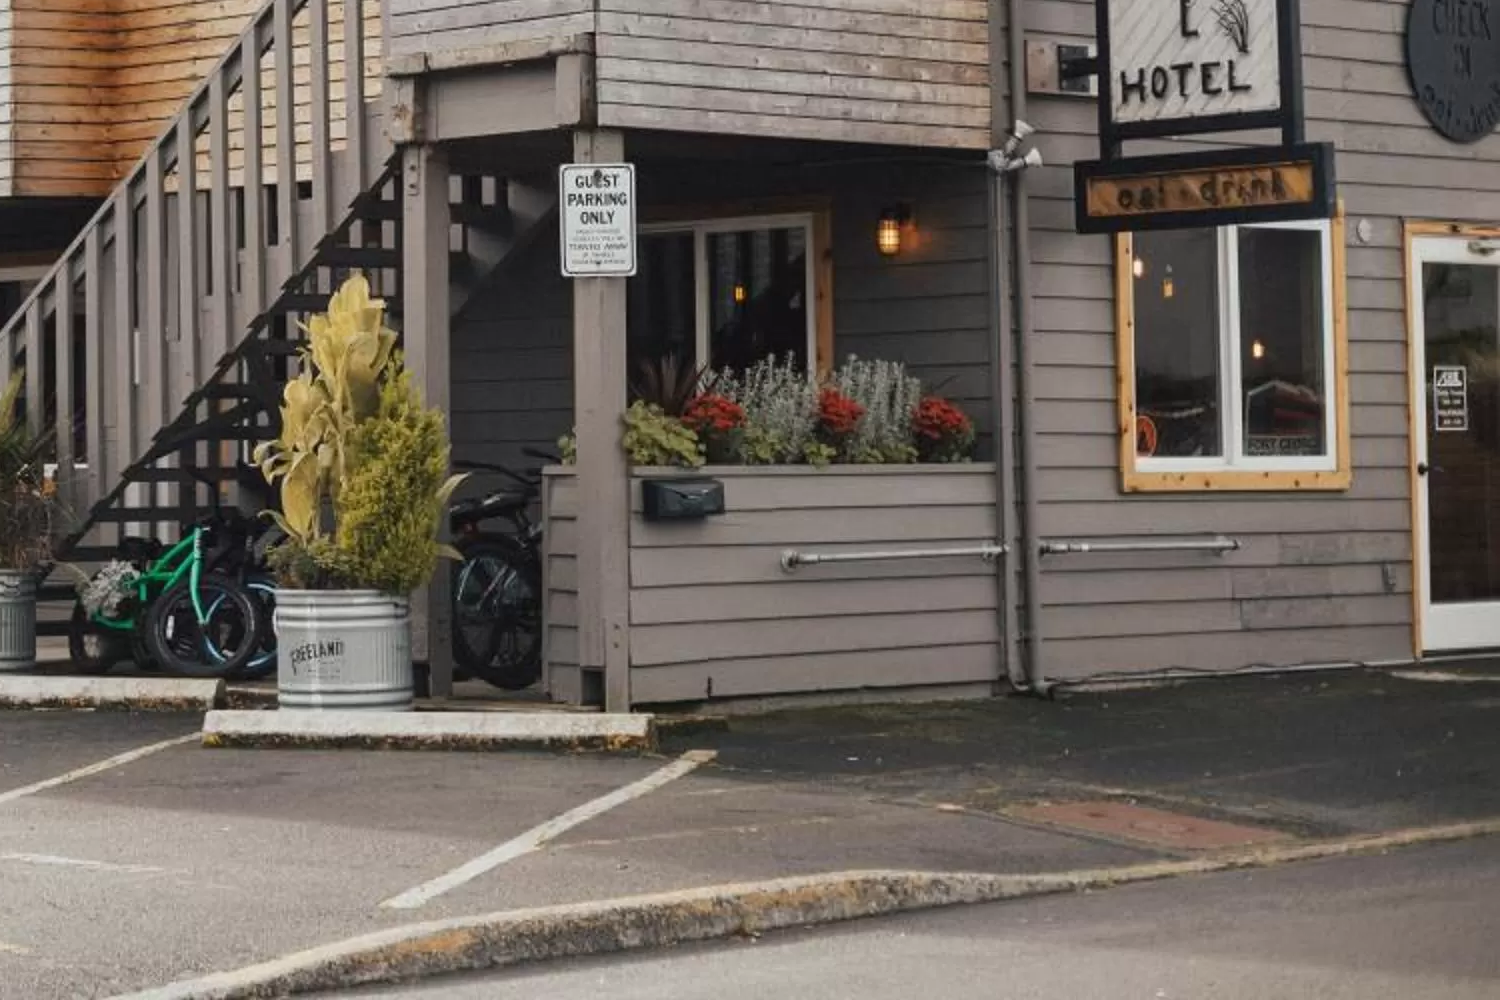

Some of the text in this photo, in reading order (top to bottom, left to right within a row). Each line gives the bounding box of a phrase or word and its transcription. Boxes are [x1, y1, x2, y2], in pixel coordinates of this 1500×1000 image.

[1453, 43, 1473, 81] IN
[1120, 60, 1252, 104] HOTEL
[575, 174, 619, 188] GUEST
[567, 192, 627, 207] PARKING
[580, 211, 615, 225] ONLY
